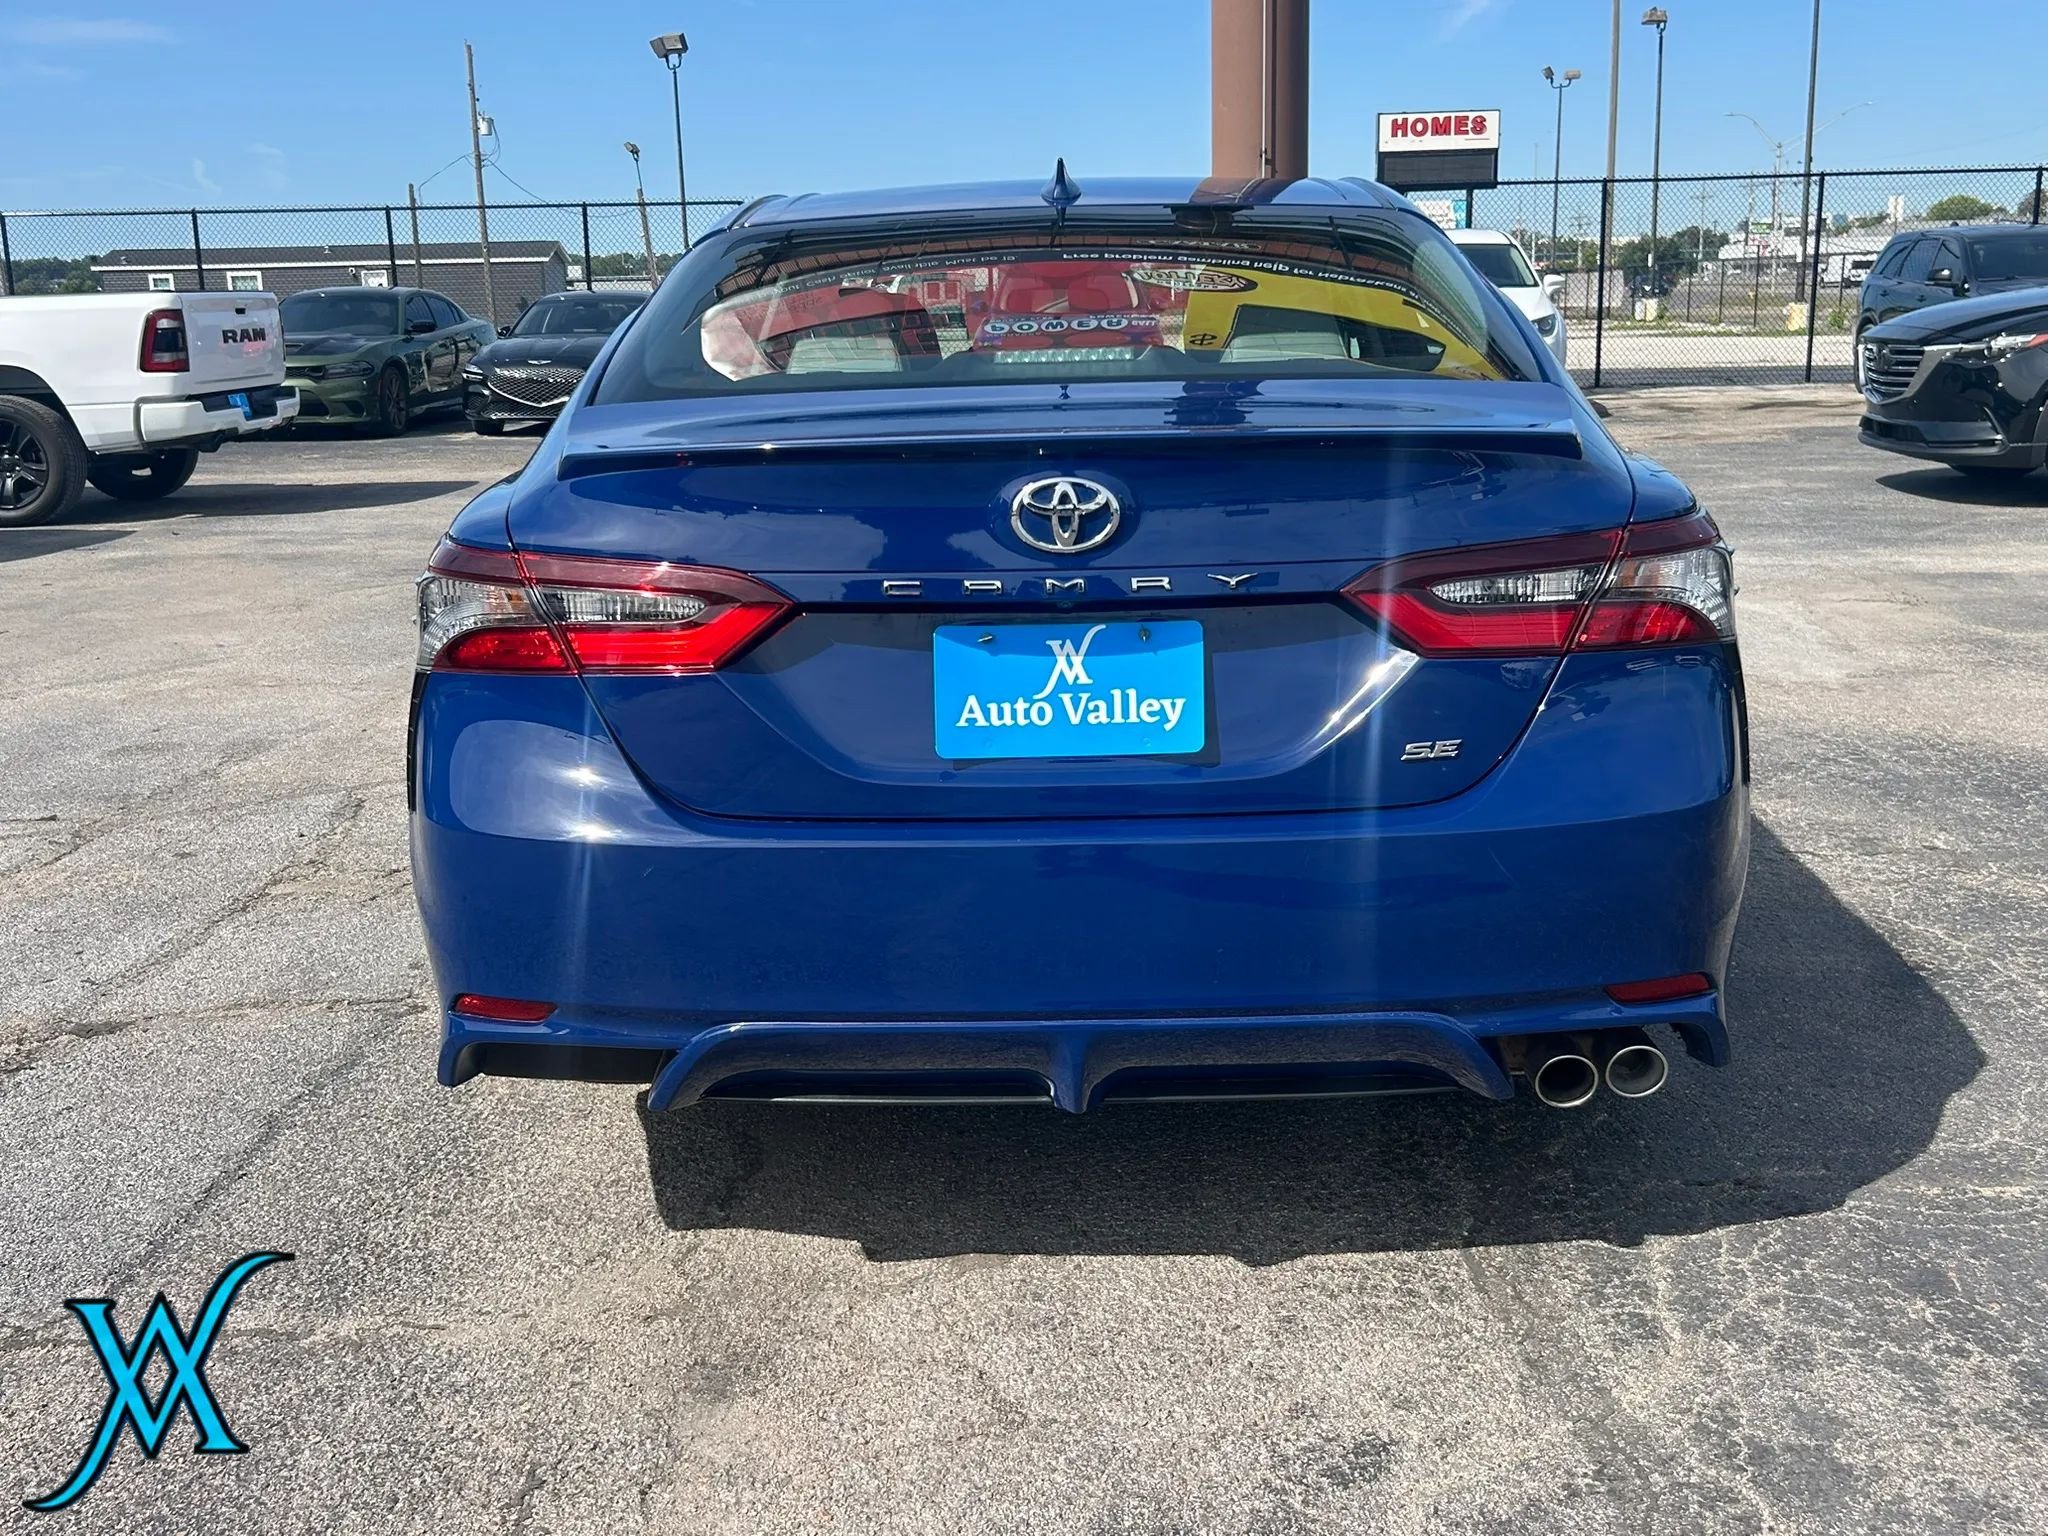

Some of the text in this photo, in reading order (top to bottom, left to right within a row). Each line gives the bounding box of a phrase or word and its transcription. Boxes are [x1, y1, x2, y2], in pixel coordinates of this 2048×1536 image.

[1391, 115, 1487, 138] HOMES
[222, 327, 266, 344] RAM
[883, 572, 1258, 595] CAMRY
[955, 688, 1187, 732] Auto Valley
[1400, 739, 1462, 760] SE
